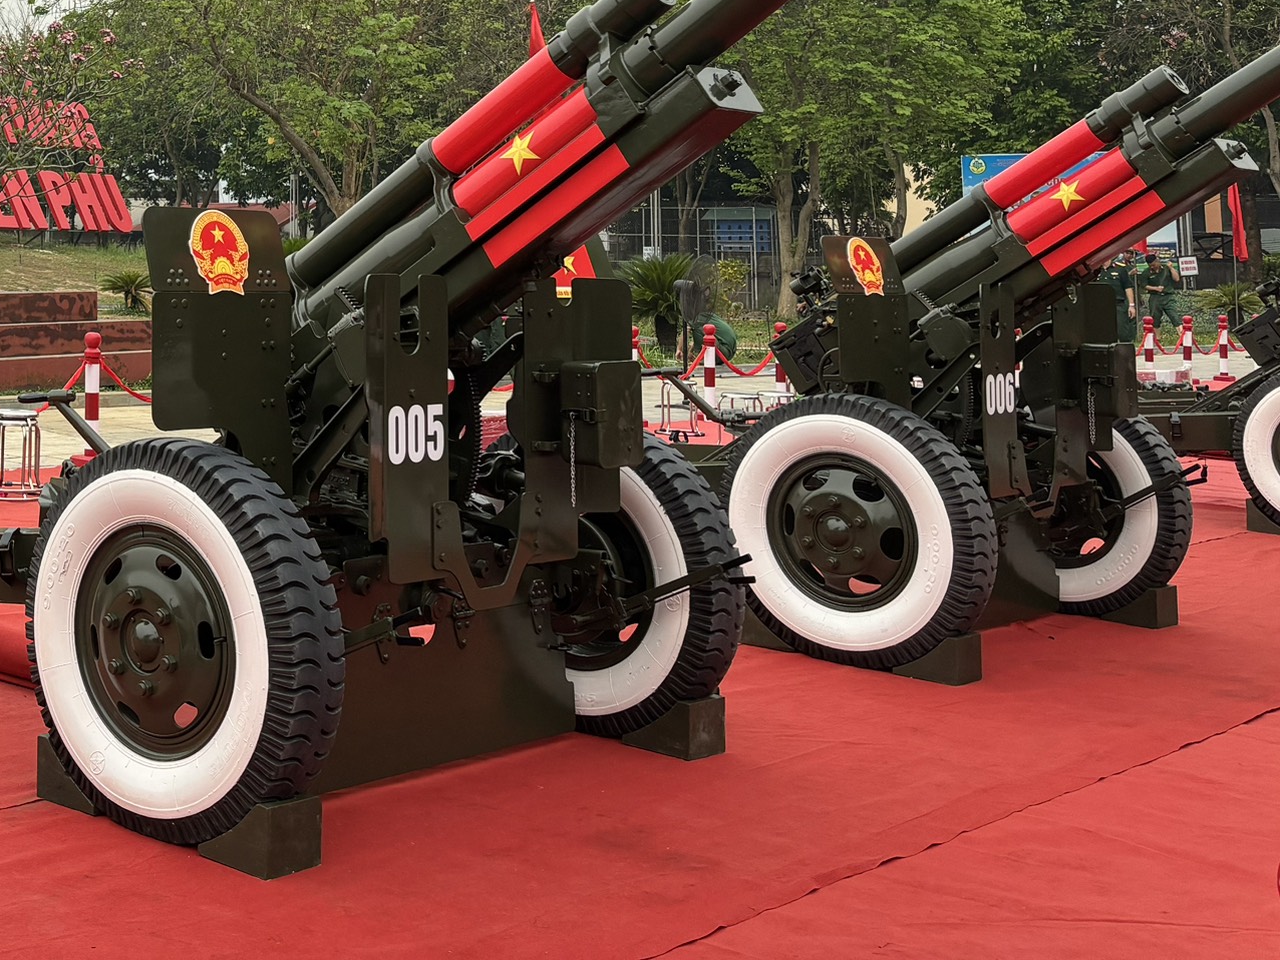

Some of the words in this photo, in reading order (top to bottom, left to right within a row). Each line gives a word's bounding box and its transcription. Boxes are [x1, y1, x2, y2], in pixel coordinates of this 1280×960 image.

[36, 153, 134, 234] PHỦ
[985, 372, 1015, 416] 006
[388, 403, 446, 466] 005
